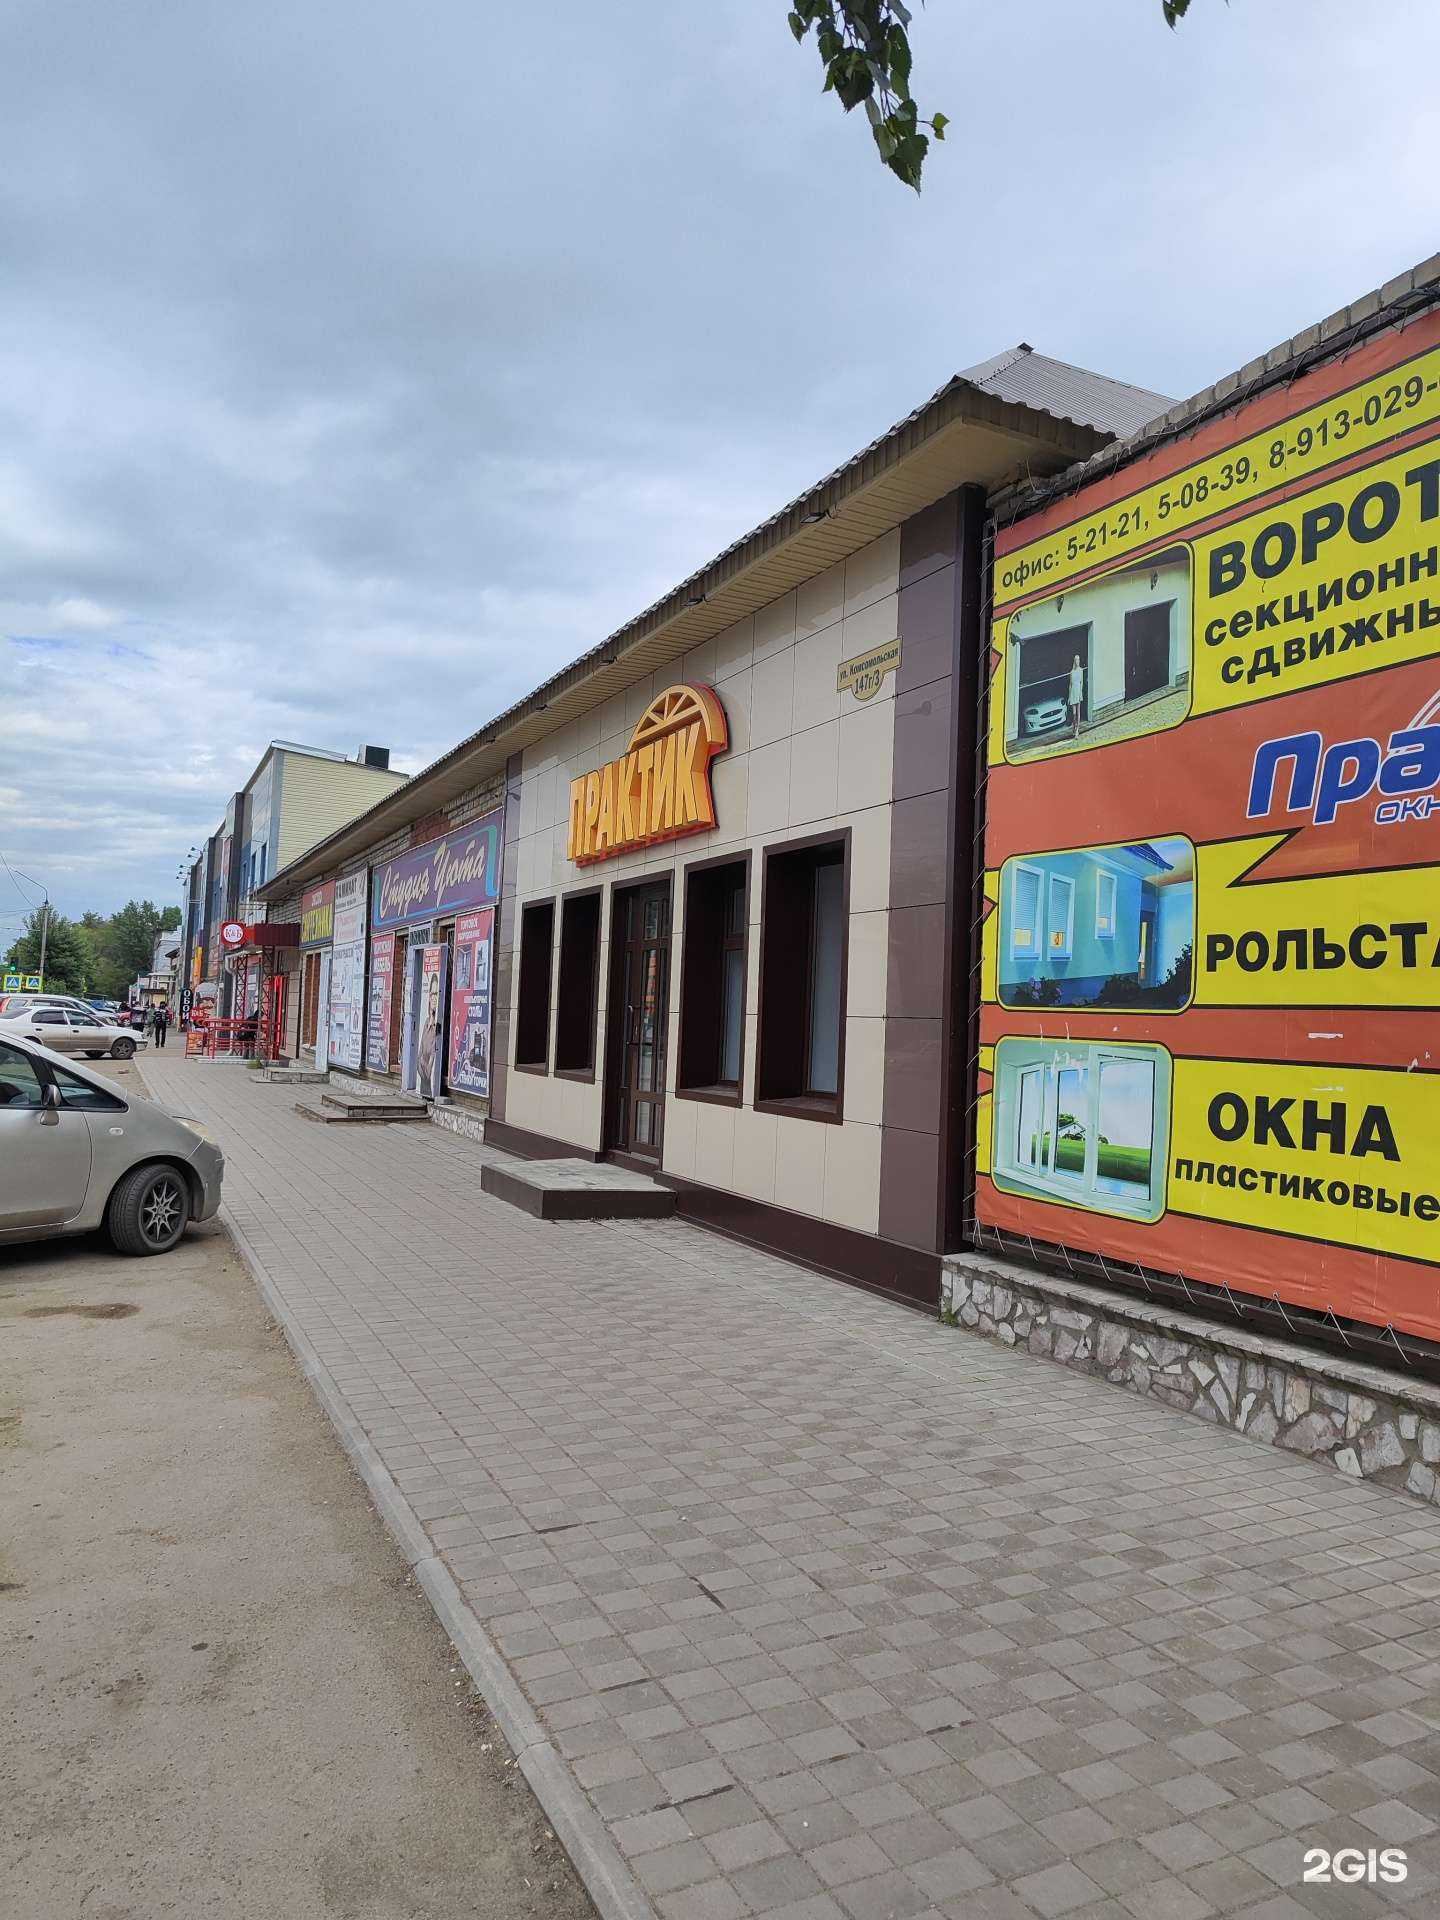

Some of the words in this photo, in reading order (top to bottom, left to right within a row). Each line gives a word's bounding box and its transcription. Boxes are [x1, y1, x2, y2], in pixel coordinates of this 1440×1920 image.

[1002, 549, 1060, 588] офис:
[1067, 506, 1149, 562] 5-21-21,
[1158, 456, 1259, 520] 5-08-39,
[1269, 375, 1440, 468] 8-913-029-
[850, 648, 899, 676] Комсомольская
[568, 721, 701, 861] ПРАКТИК
[380, 865, 430, 919] Студия
[433, 840, 486, 909] Уюта
[1206, 921, 1440, 973] РОЛЬСТ
[182, 989, 190, 1020] ОБОИ
[1207, 1092, 1402, 1162] ОКНА
[1175, 1158, 1440, 1221] пластиковые
